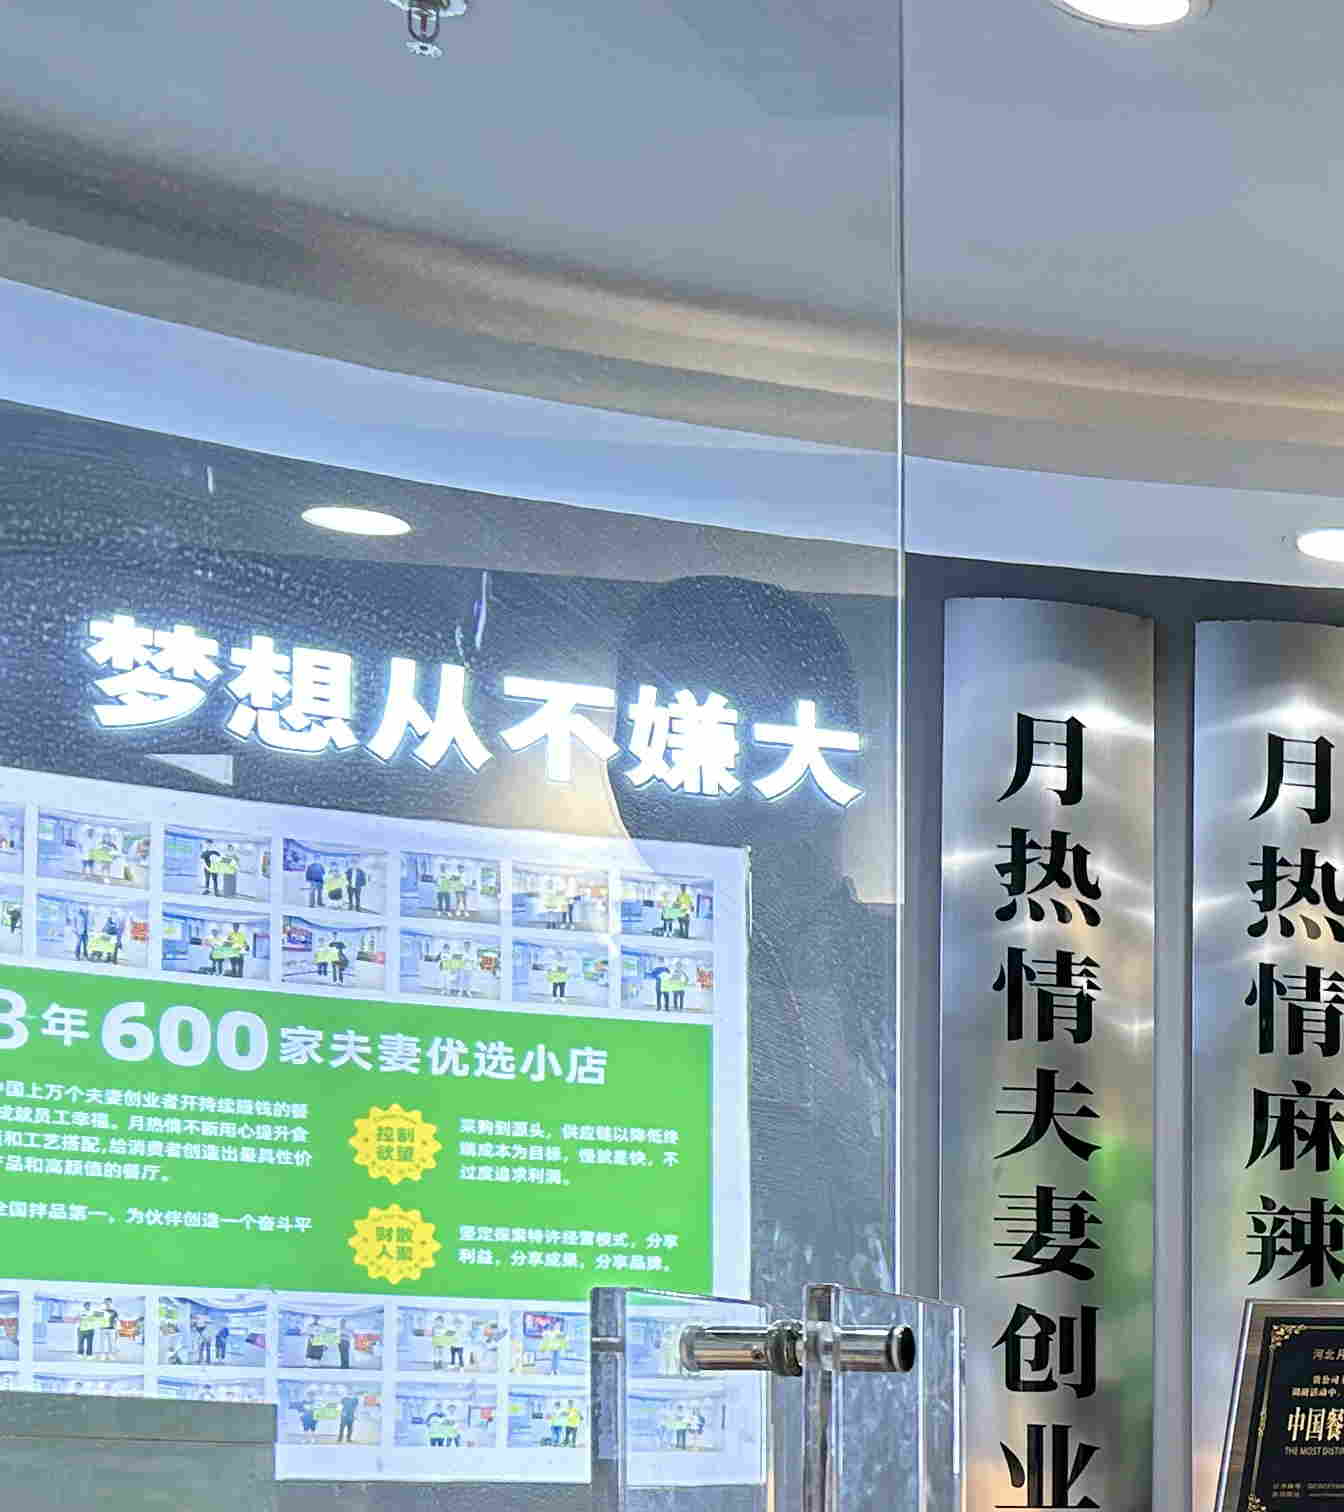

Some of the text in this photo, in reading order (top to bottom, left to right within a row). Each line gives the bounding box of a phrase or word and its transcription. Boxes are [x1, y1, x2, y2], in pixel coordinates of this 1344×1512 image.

[86, 613, 864, 807] 梦想从不嫌大
[0, 1154, 170, 1182] 品和高颜值的餐厅。
